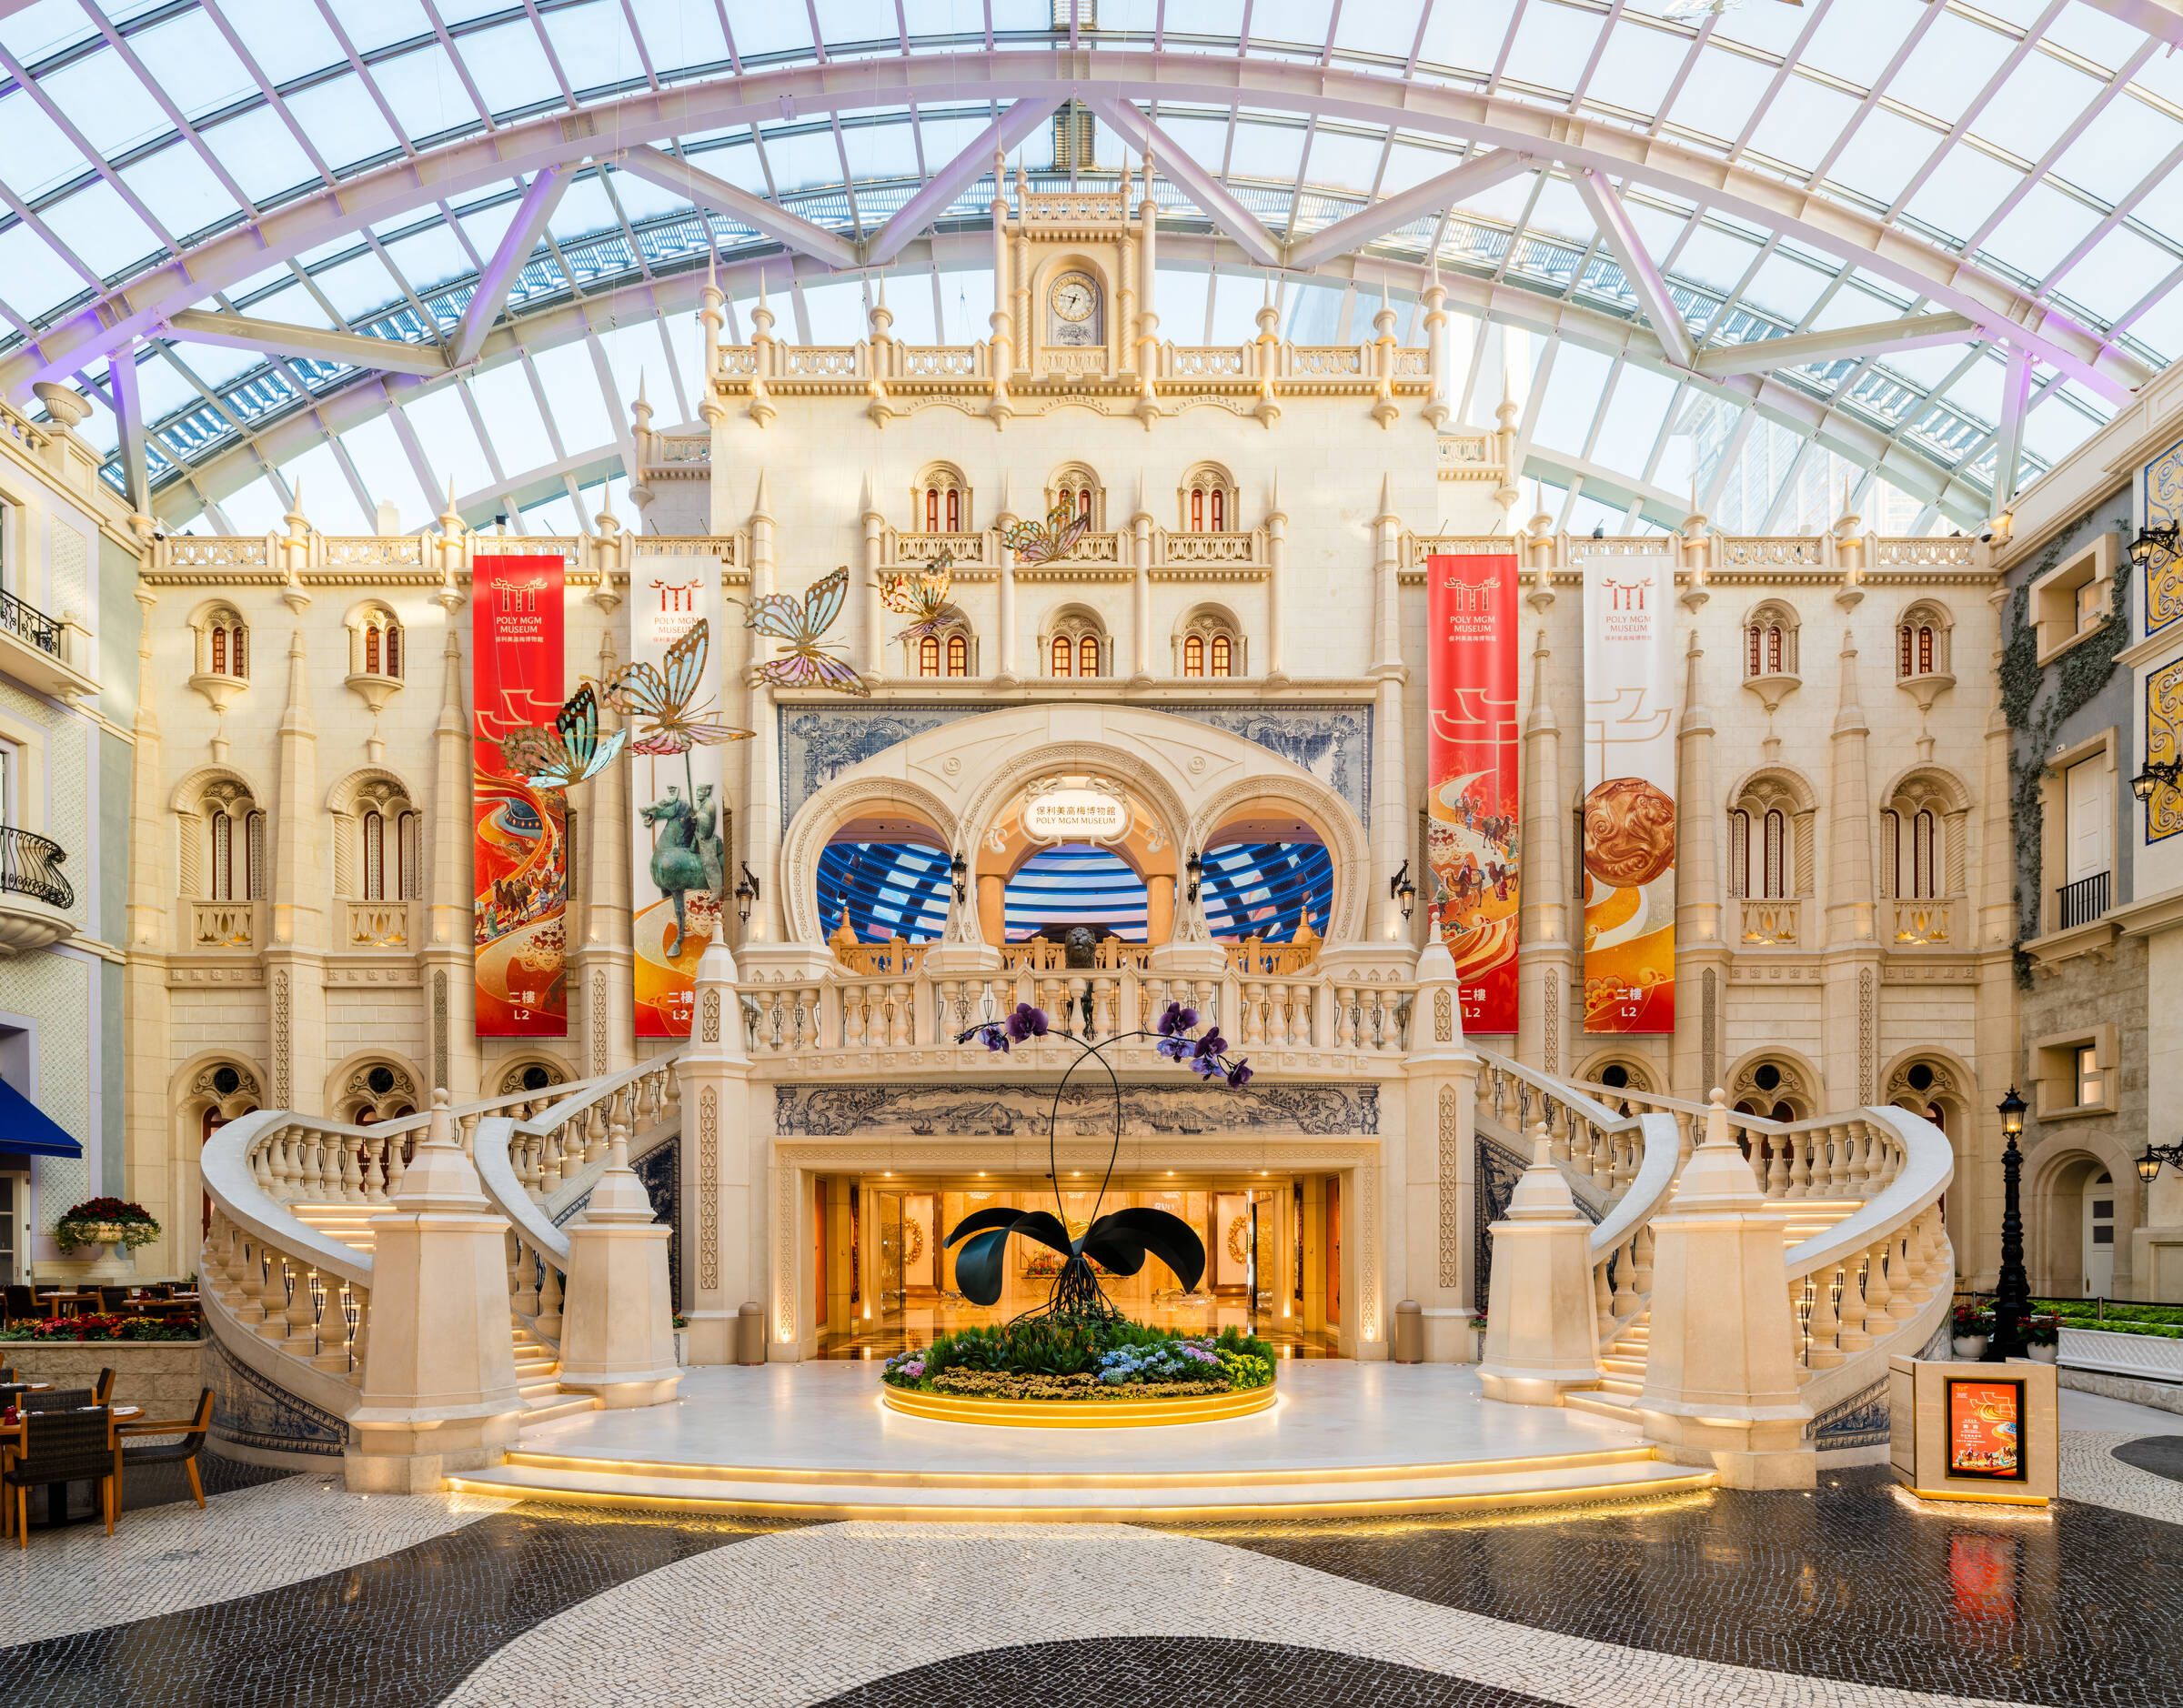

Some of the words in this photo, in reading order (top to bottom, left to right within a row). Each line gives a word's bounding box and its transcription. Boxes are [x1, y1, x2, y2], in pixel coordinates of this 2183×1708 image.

[1449, 616, 1472, 624] POLY
[1474, 616, 1495, 624] MGM
[500, 625, 538, 633] MUSEUM
[1454, 625, 1492, 633] MUSEUM
[1036, 806, 1116, 816] 保利美高梅博物館
[508, 990, 536, 1004] 二樓
[668, 990, 694, 1004] 二樓
[1459, 988, 1486, 1001] 二樓
[1615, 987, 1643, 1001] 二樓
[514, 1010, 529, 1020] L2
[673, 1010, 689, 1020] L2
[1465, 1007, 1481, 1018] L2
[1621, 1006, 1636, 1017] L2
